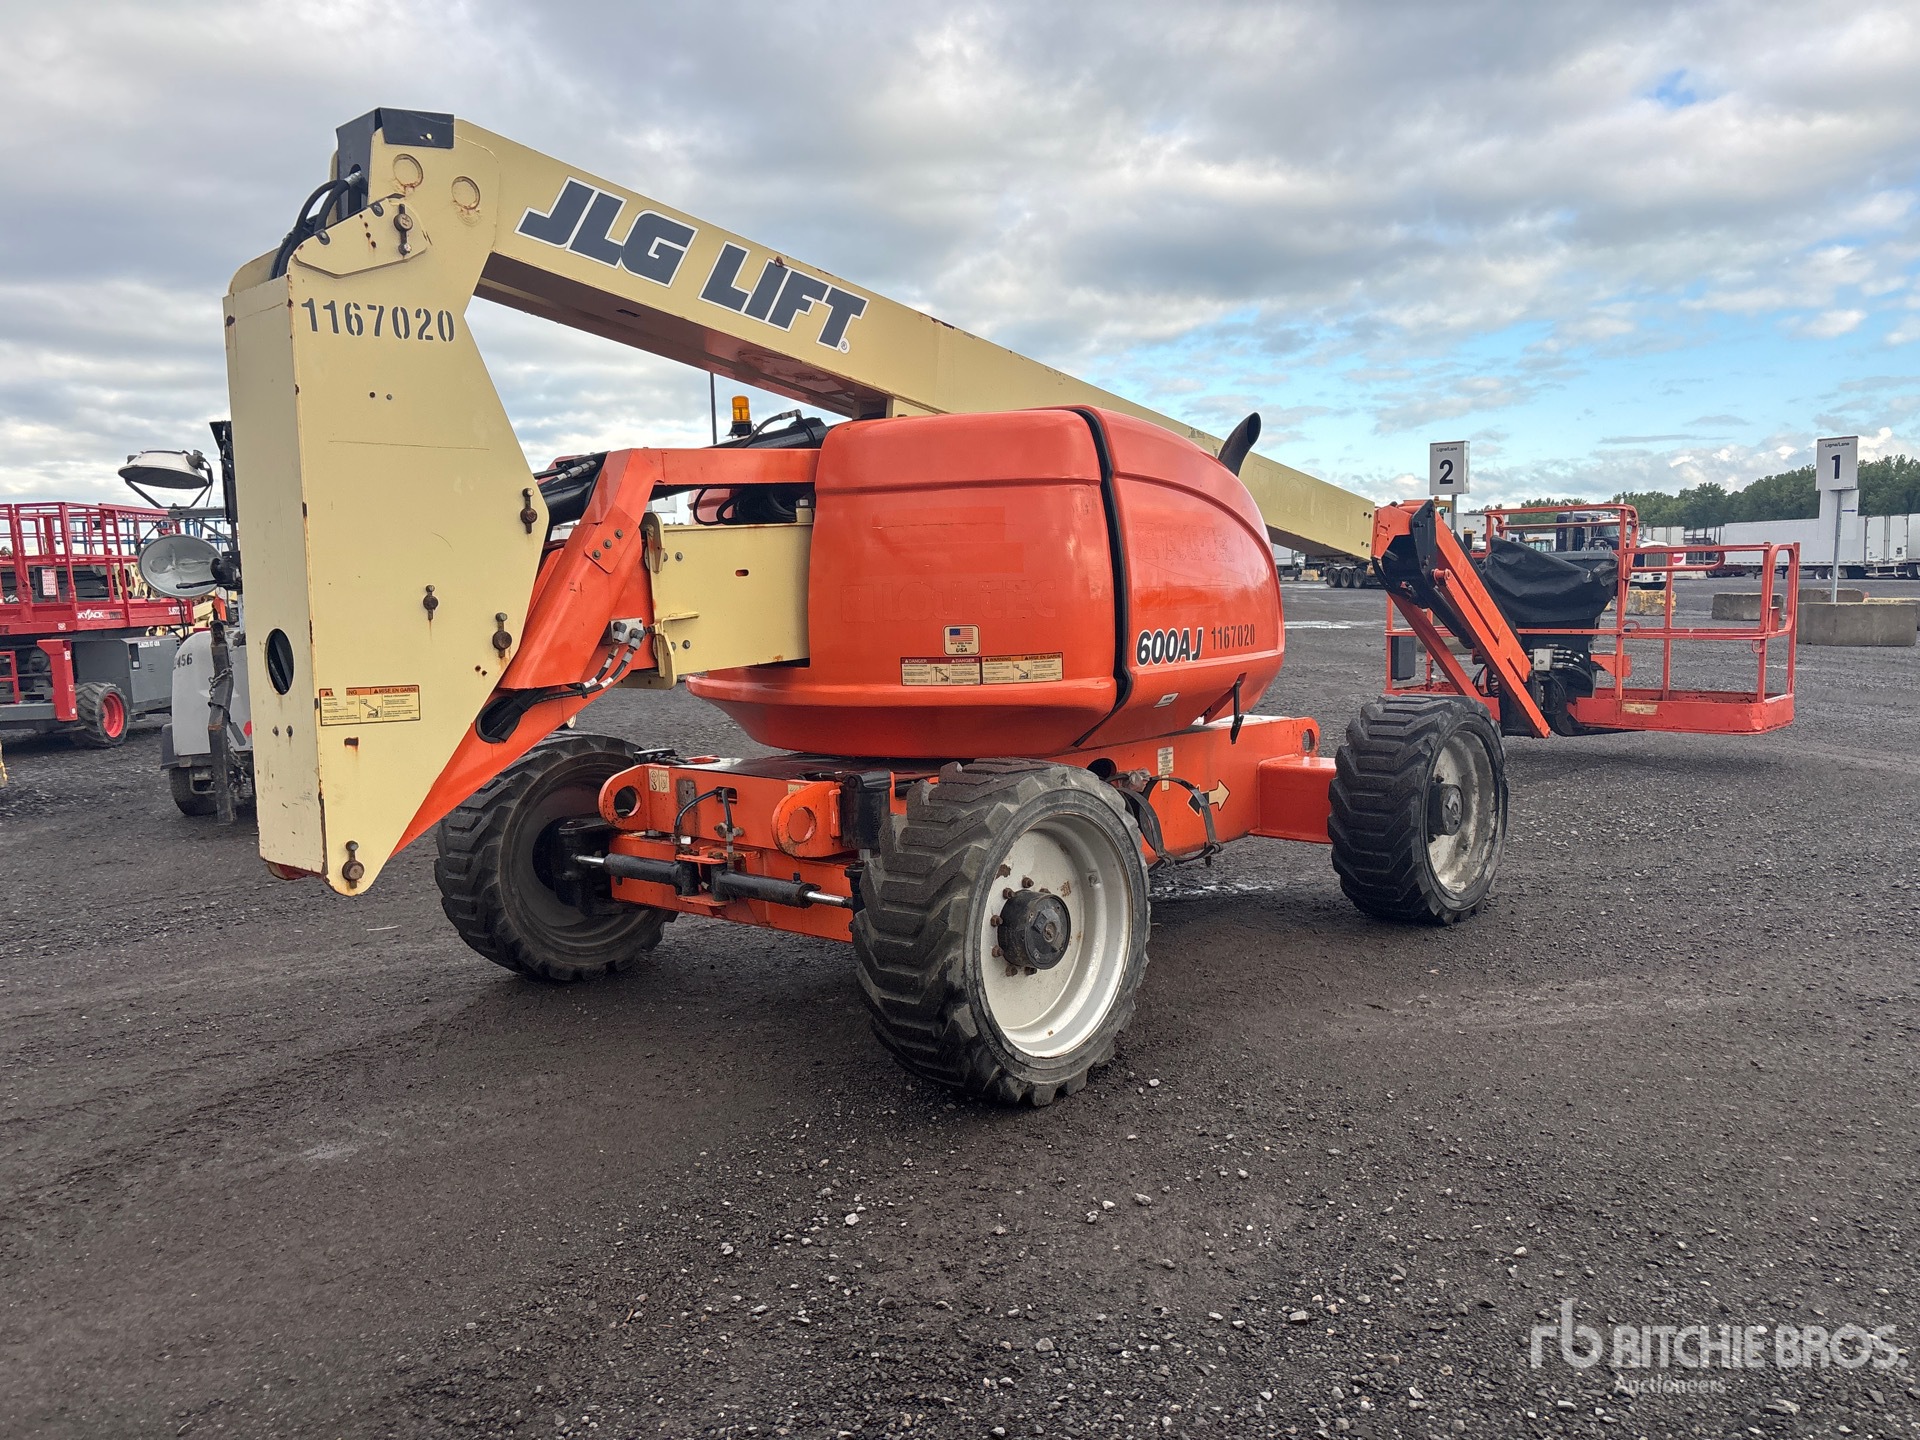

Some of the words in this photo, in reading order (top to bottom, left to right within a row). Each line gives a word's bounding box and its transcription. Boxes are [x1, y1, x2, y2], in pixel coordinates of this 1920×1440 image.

[514, 175, 699, 288] JLG
[697, 240, 870, 351] LIFT
[301, 297, 456, 342] 1167020
[1439, 459, 1454, 485] 2
[1831, 454, 1841, 480] 1
[1136, 627, 1204, 667] 600AJ
[1211, 624, 1255, 650] 1167020
